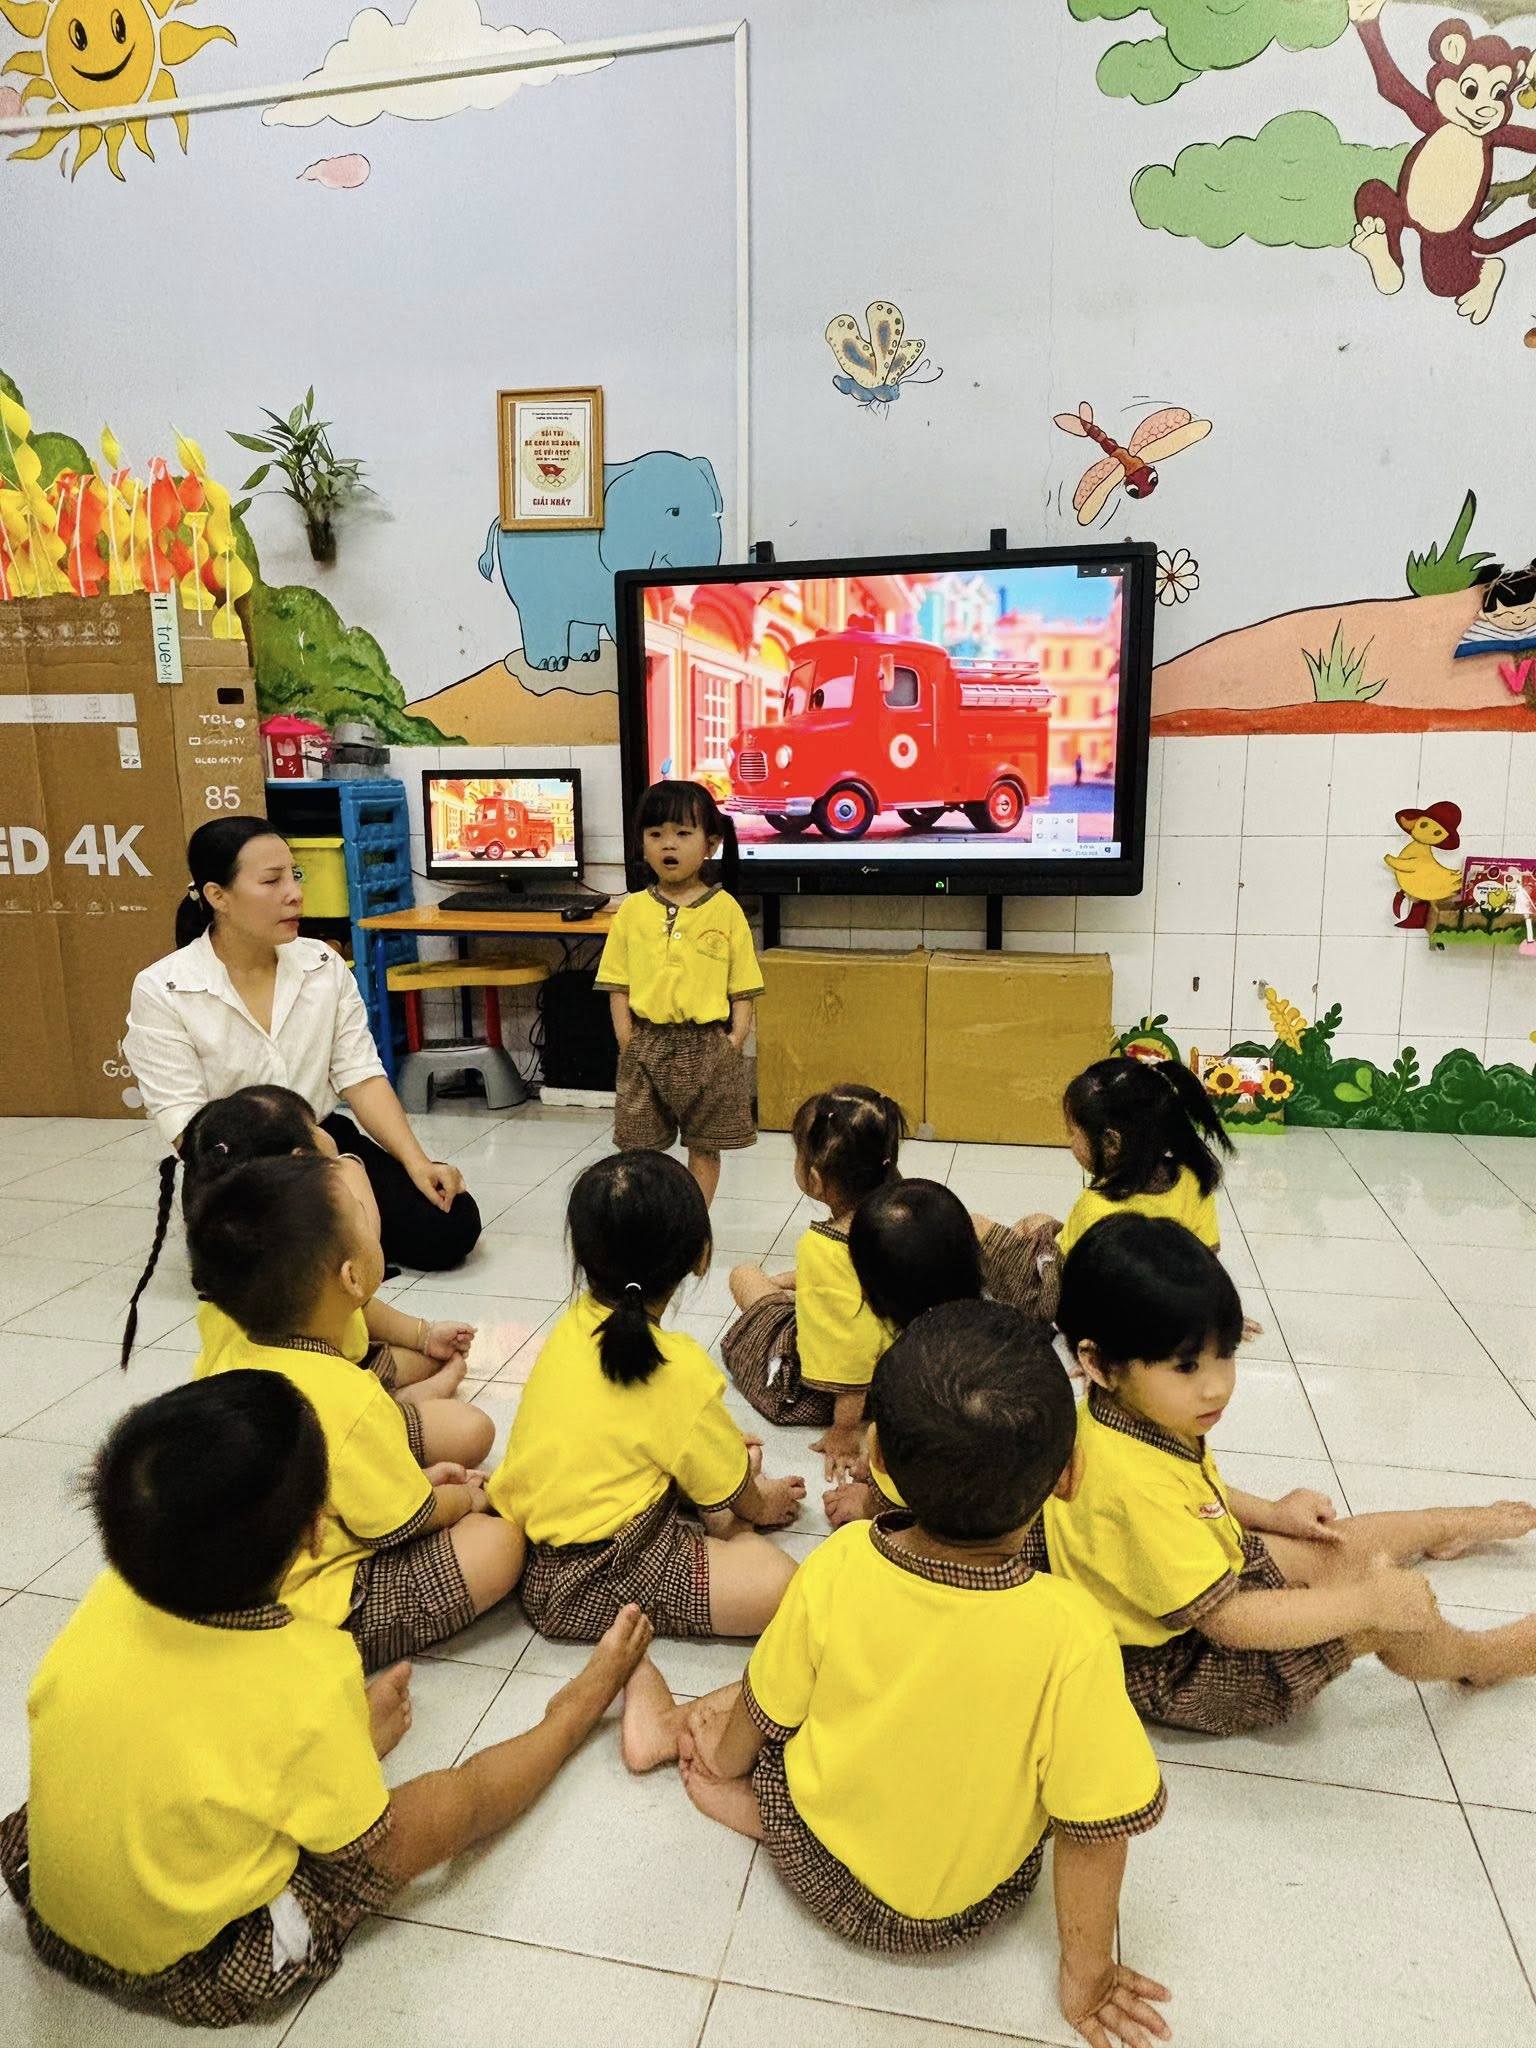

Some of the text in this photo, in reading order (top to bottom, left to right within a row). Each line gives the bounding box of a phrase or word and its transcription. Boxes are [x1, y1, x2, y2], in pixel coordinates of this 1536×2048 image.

[198, 714, 231, 725] TCL
[204, 785, 241, 810] 85
[64, 823, 153, 877] 4K
